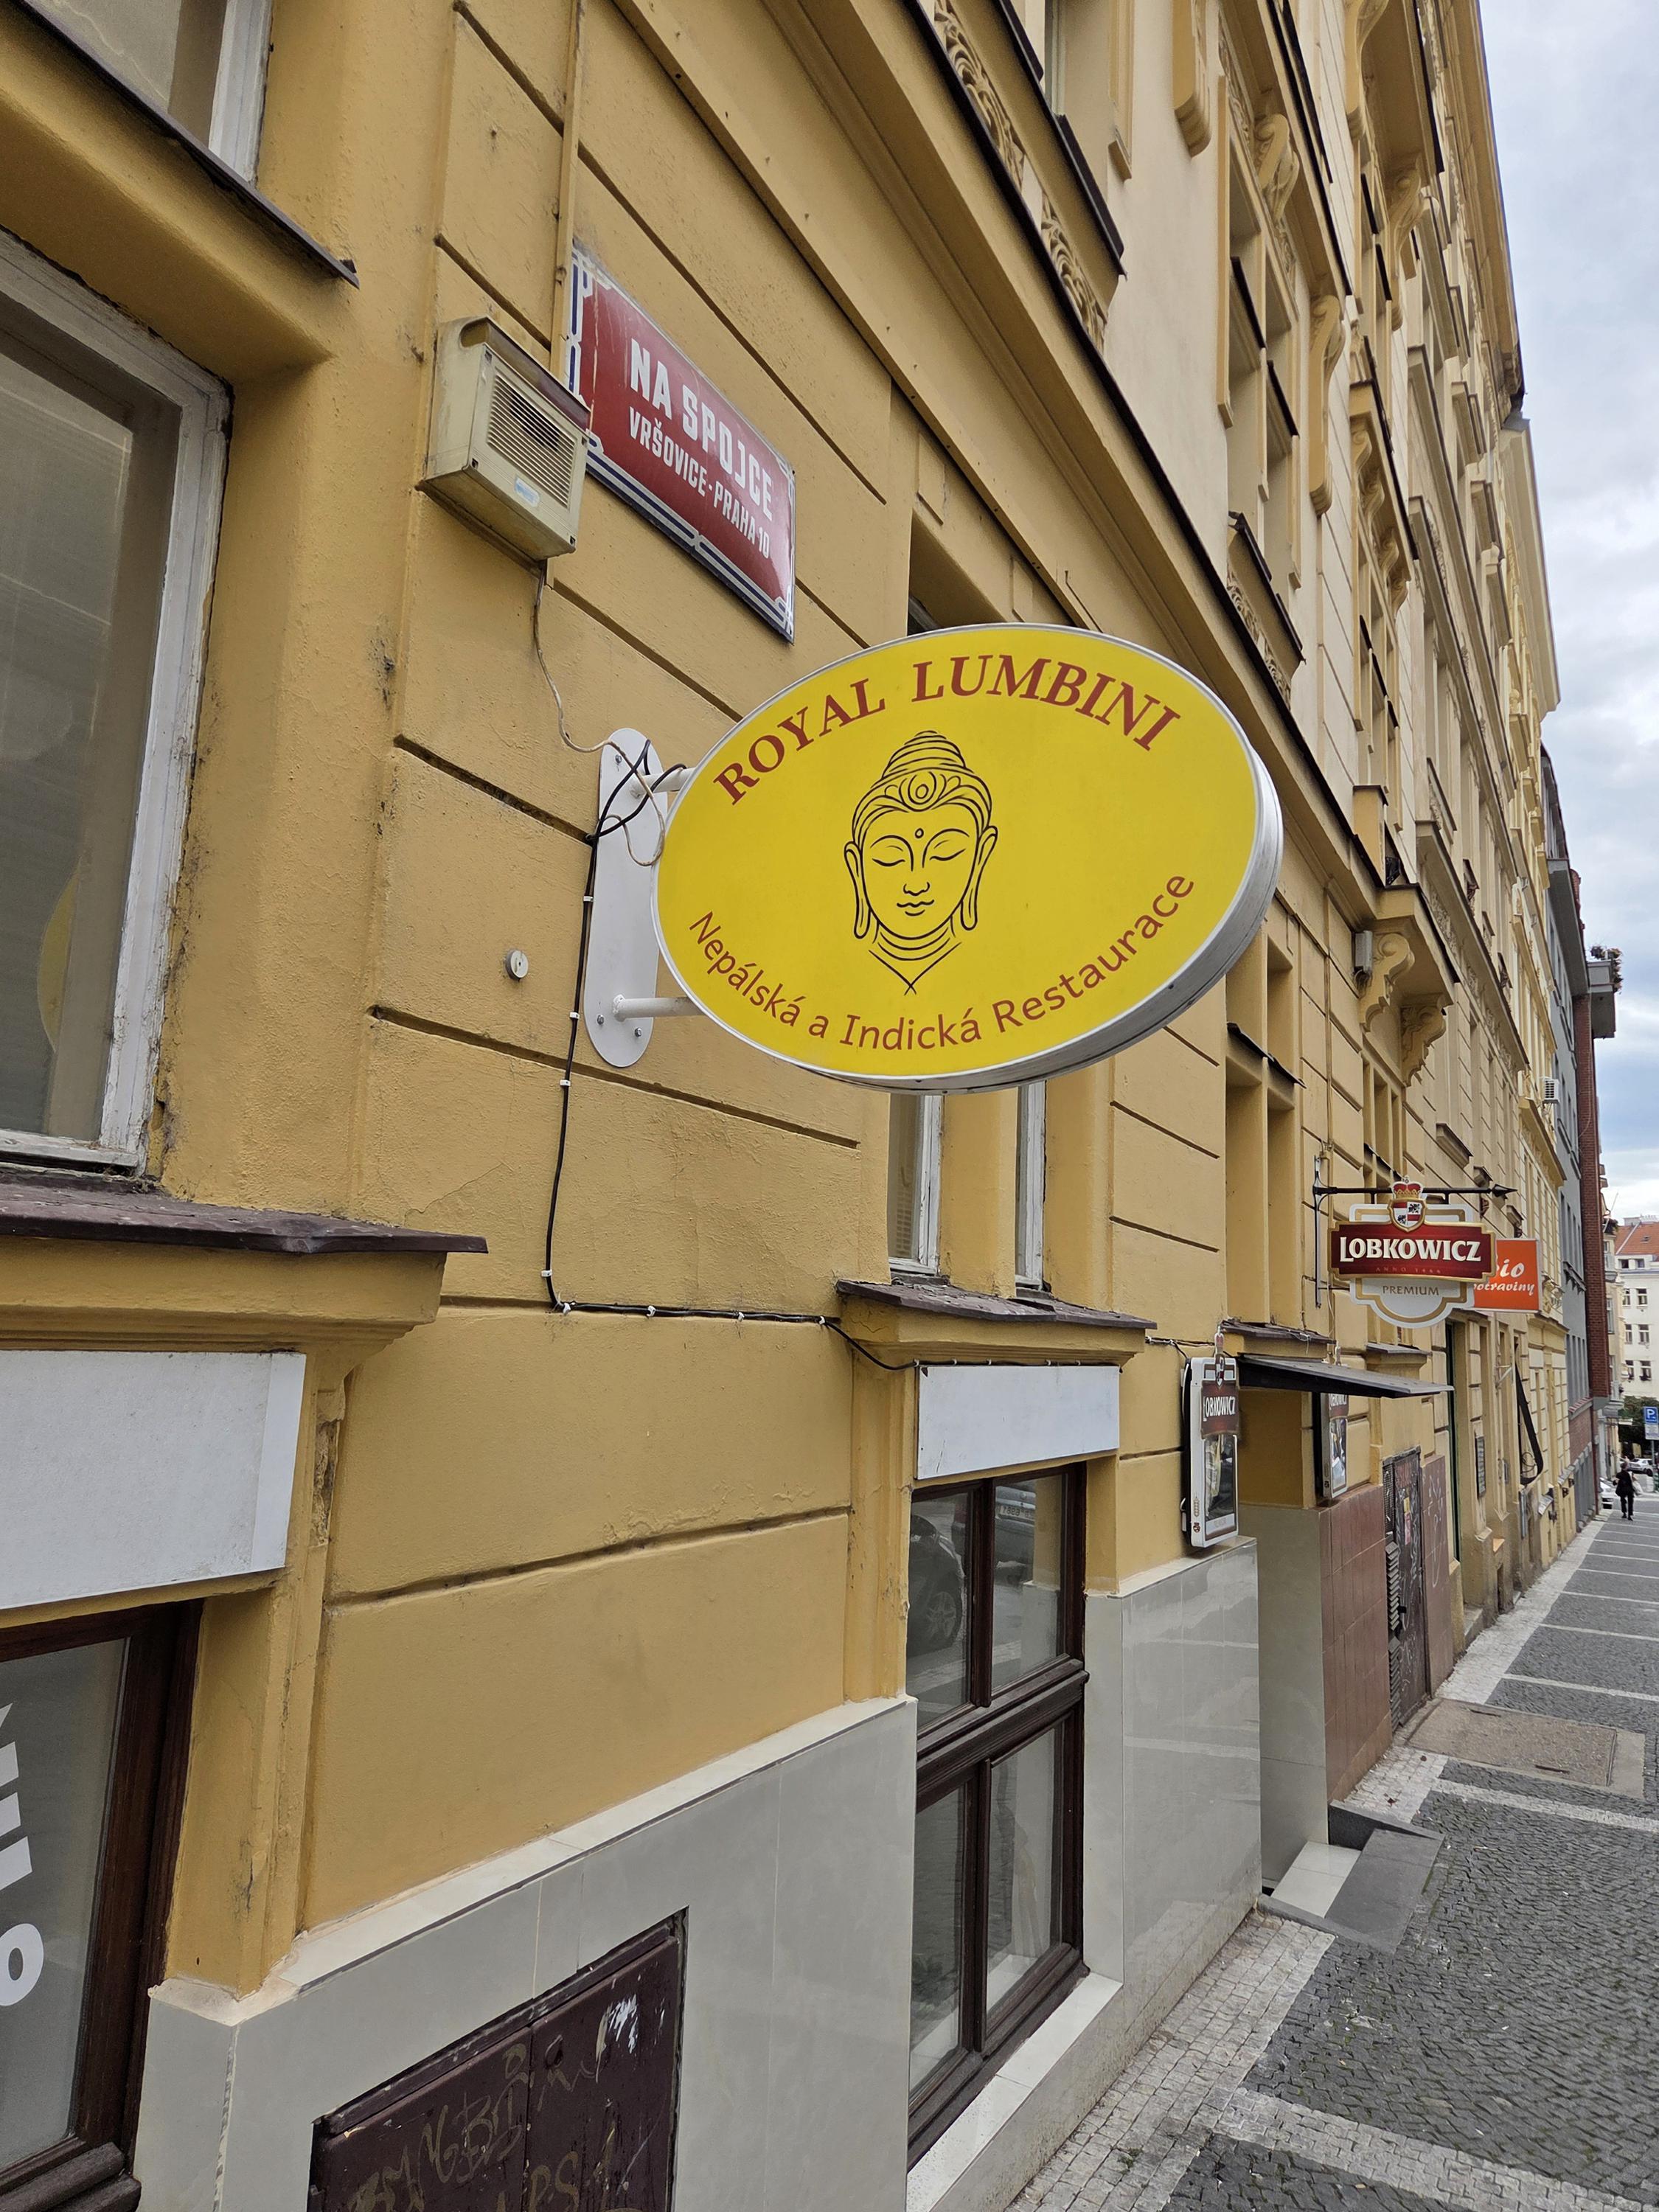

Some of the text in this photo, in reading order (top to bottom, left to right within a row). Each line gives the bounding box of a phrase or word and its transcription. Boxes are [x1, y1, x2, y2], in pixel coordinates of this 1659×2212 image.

[630, 338, 773, 521] NA SPOJCE
[759, 527, 770, 559] 10
[712, 654, 1181, 805] ROYAL LUMBINI
[689, 875, 1194, 1051] Nepálská a Indická Restaurace
[1340, 1237, 1481, 1262] LOBKOWICZ
[1496, 1259, 1525, 1278] io
[1382, 1285, 1439, 1295] PREMIUM
[1203, 1395, 1236, 1422] LOBKOWICZ
